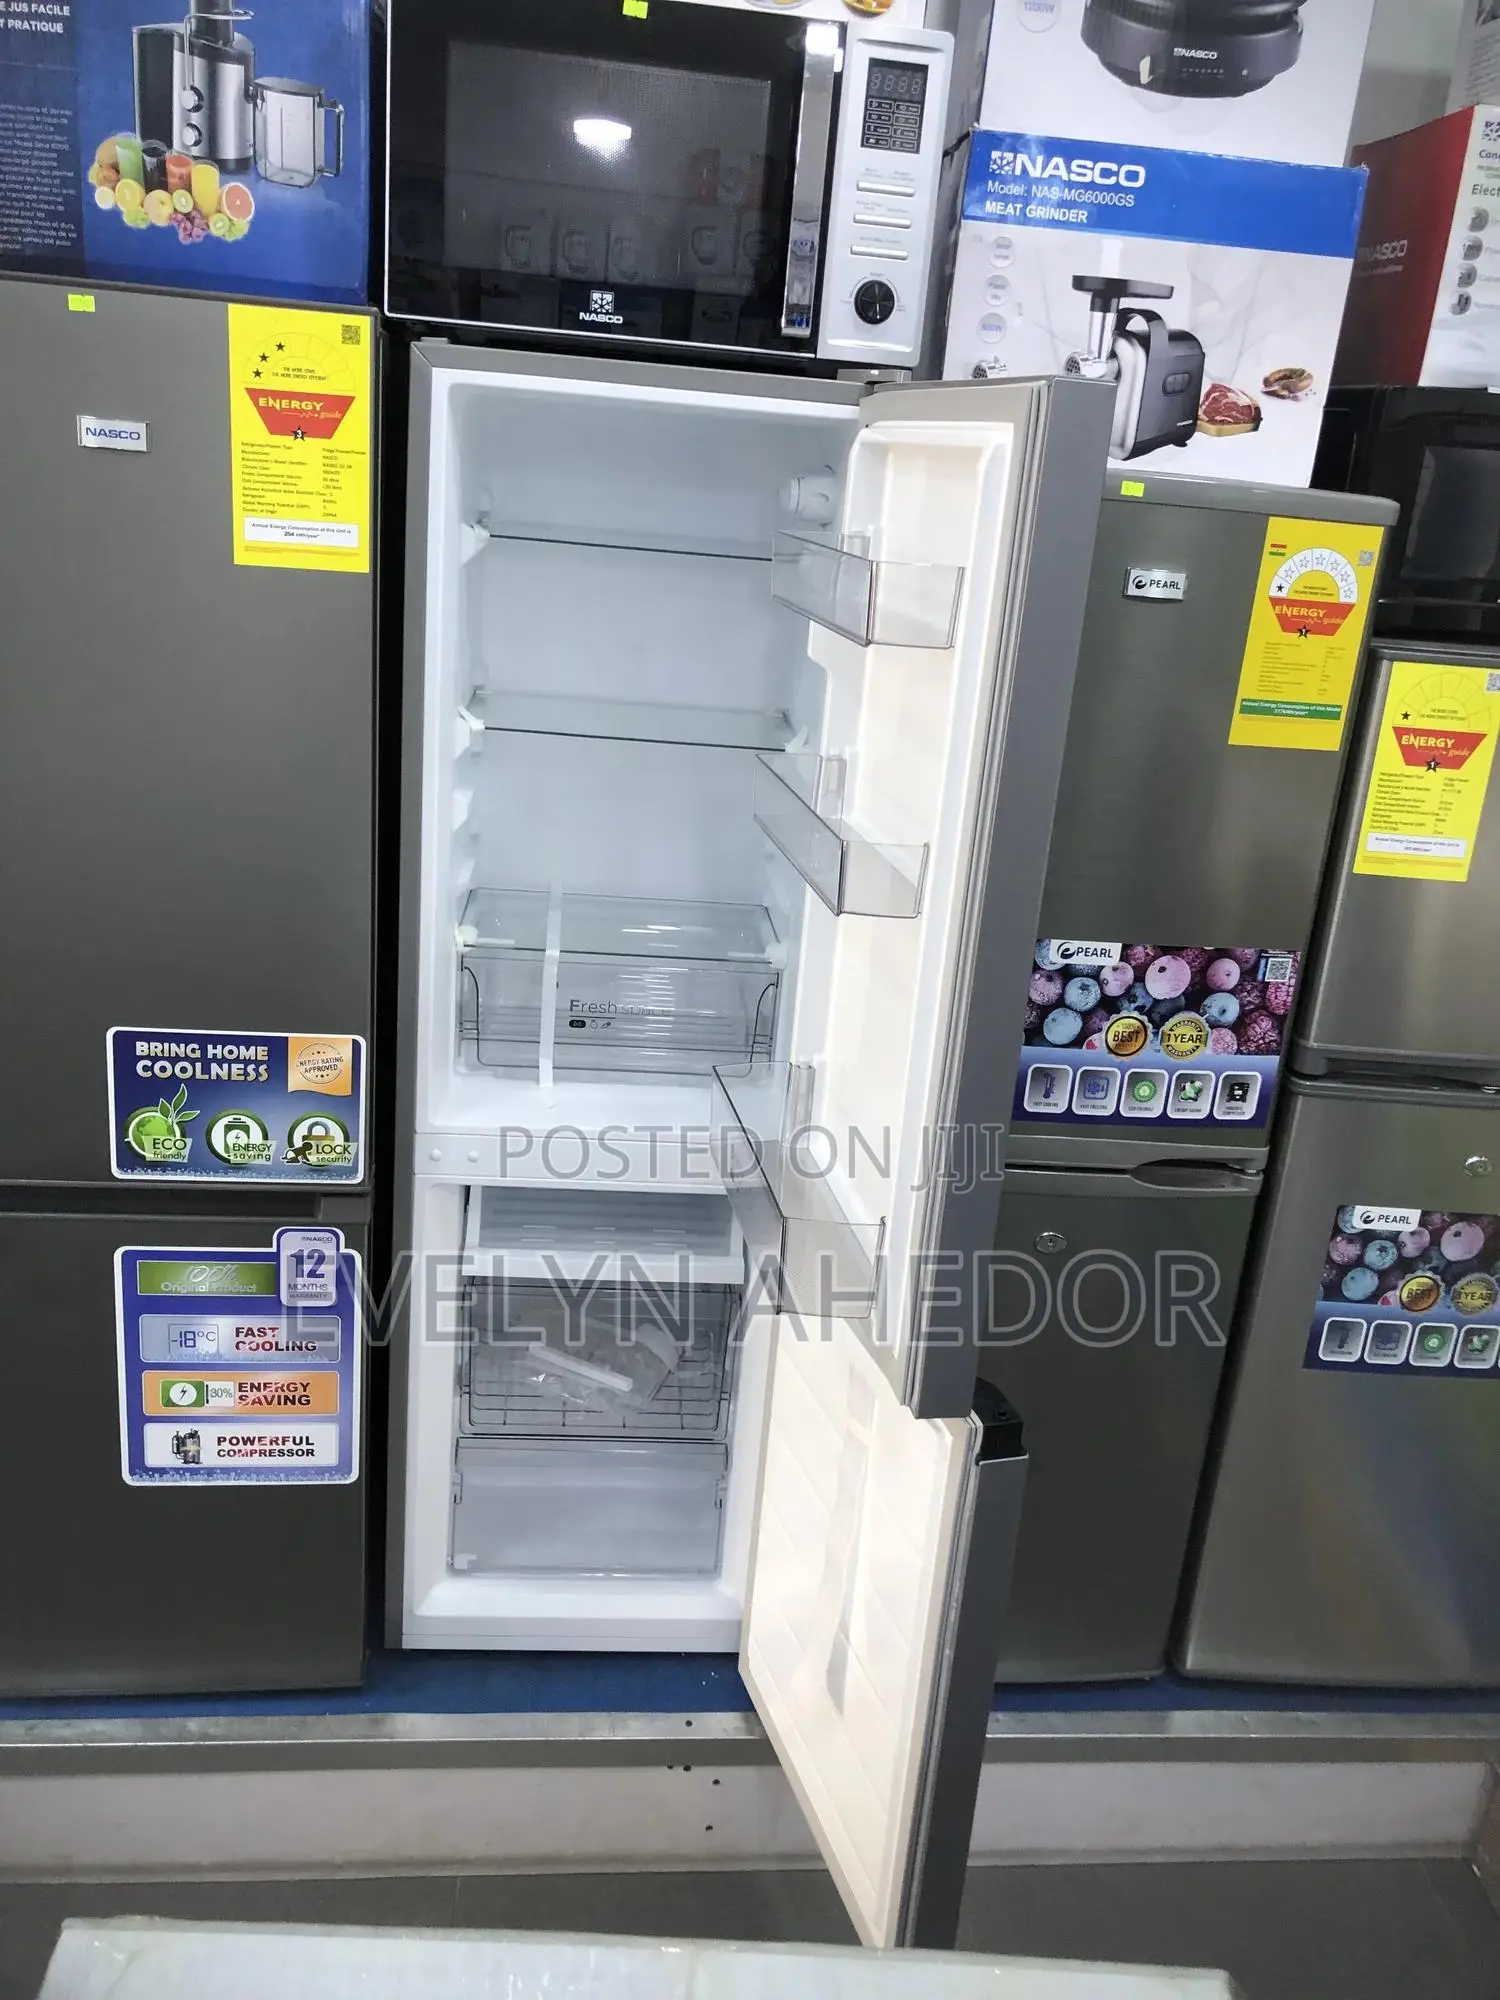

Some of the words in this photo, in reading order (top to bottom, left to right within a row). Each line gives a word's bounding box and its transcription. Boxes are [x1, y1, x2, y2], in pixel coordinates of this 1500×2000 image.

[8, 2, 29, 13] JUS
[31, 4, 71, 16] FACILE
[1024, 1, 1055, 14] 1200W
[8, 20, 64, 34] PRATIQUE
[1181, 48, 1217, 60] NASCO
[1014, 153, 1146, 188] NASCO
[987, 180, 1028, 197] Model:
[1031, 184, 1135, 207] NAS-MG6000GS
[985, 201, 1023, 216] MEAT
[1026, 205, 1088, 223] GRINDER
[1366, 240, 1408, 261] NASCO
[579, 311, 623, 324] NASCO
[257, 396, 325, 411] ENERGY
[85, 427, 140, 440] NASCO
[296, 429, 303, 438] 3
[1149, 579, 1182, 590] PEARL
[1275, 604, 1328, 618] ENERGY
[1401, 732, 1456, 749] ENERGY
[1075, 945, 1113, 960] PEARL
[569, 999, 618, 1015] Fresh
[1112, 1030, 1141, 1043] BEST
[1173, 1034, 1203, 1044] YEAR
[135, 1041, 201, 1059] BRING
[207, 1044, 268, 1061] HOME
[135, 1060, 269, 1082] COOLNESS
[304, 1064, 338, 1074] APPROVED
[152, 1138, 187, 1151] ECO
[232, 1142, 272, 1152] ENERGY
[315, 1143, 351, 1155] LOCK
[153, 1150, 186, 1161] friendly
[232, 1151, 271, 1162] saving
[315, 1154, 352, 1165] security
[1377, 1214, 1412, 1225] PEARL
[289, 1248, 327, 1279] 12
[161, 1281, 209, 1294] Original
[288, 1283, 328, 1291] MONTHS
[1464, 1291, 1492, 1301] YEAR
[235, 1327, 280, 1338] FAST
[235, 1340, 318, 1352] COOLING
[210, 1387, 234, 1399] 30%
[238, 1381, 311, 1393] ENERGY
[238, 1394, 312, 1406] SAVING
[217, 1435, 315, 1447] POWERFUL
[217, 1448, 315, 1458] COMPRESSOR
